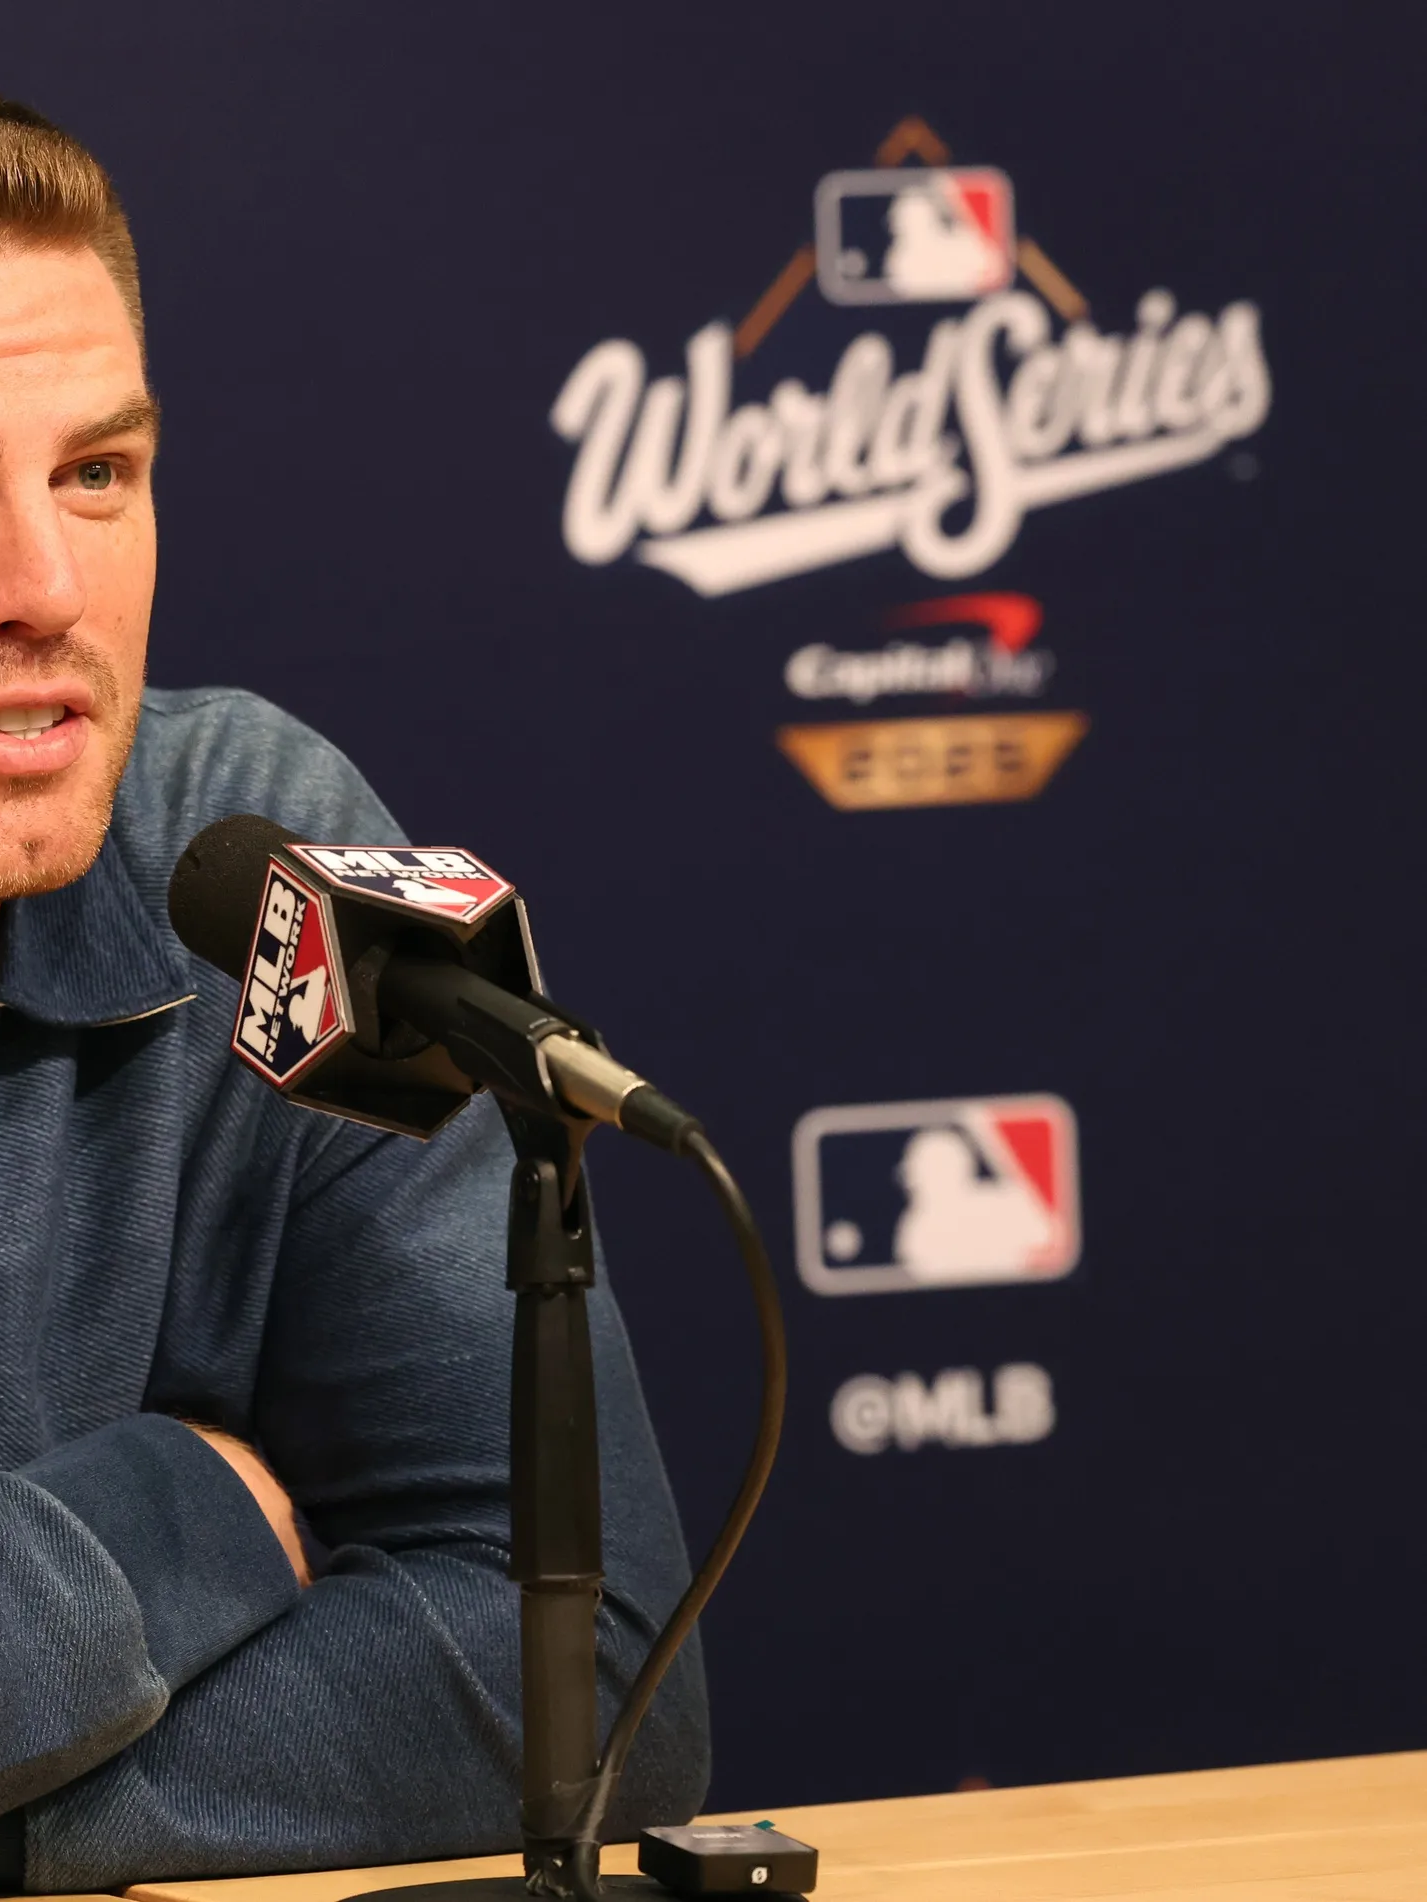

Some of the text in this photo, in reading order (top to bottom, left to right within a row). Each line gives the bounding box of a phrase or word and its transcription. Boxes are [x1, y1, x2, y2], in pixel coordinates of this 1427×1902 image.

[550, 287, 1272, 581] World Series
[307, 849, 477, 874] MLB
[331, 868, 491, 881] NETWORK
[240, 880, 296, 1057] MLB
[264, 899, 308, 1064] NETWORK
[829, 1361, 1056, 1456] @MLB
